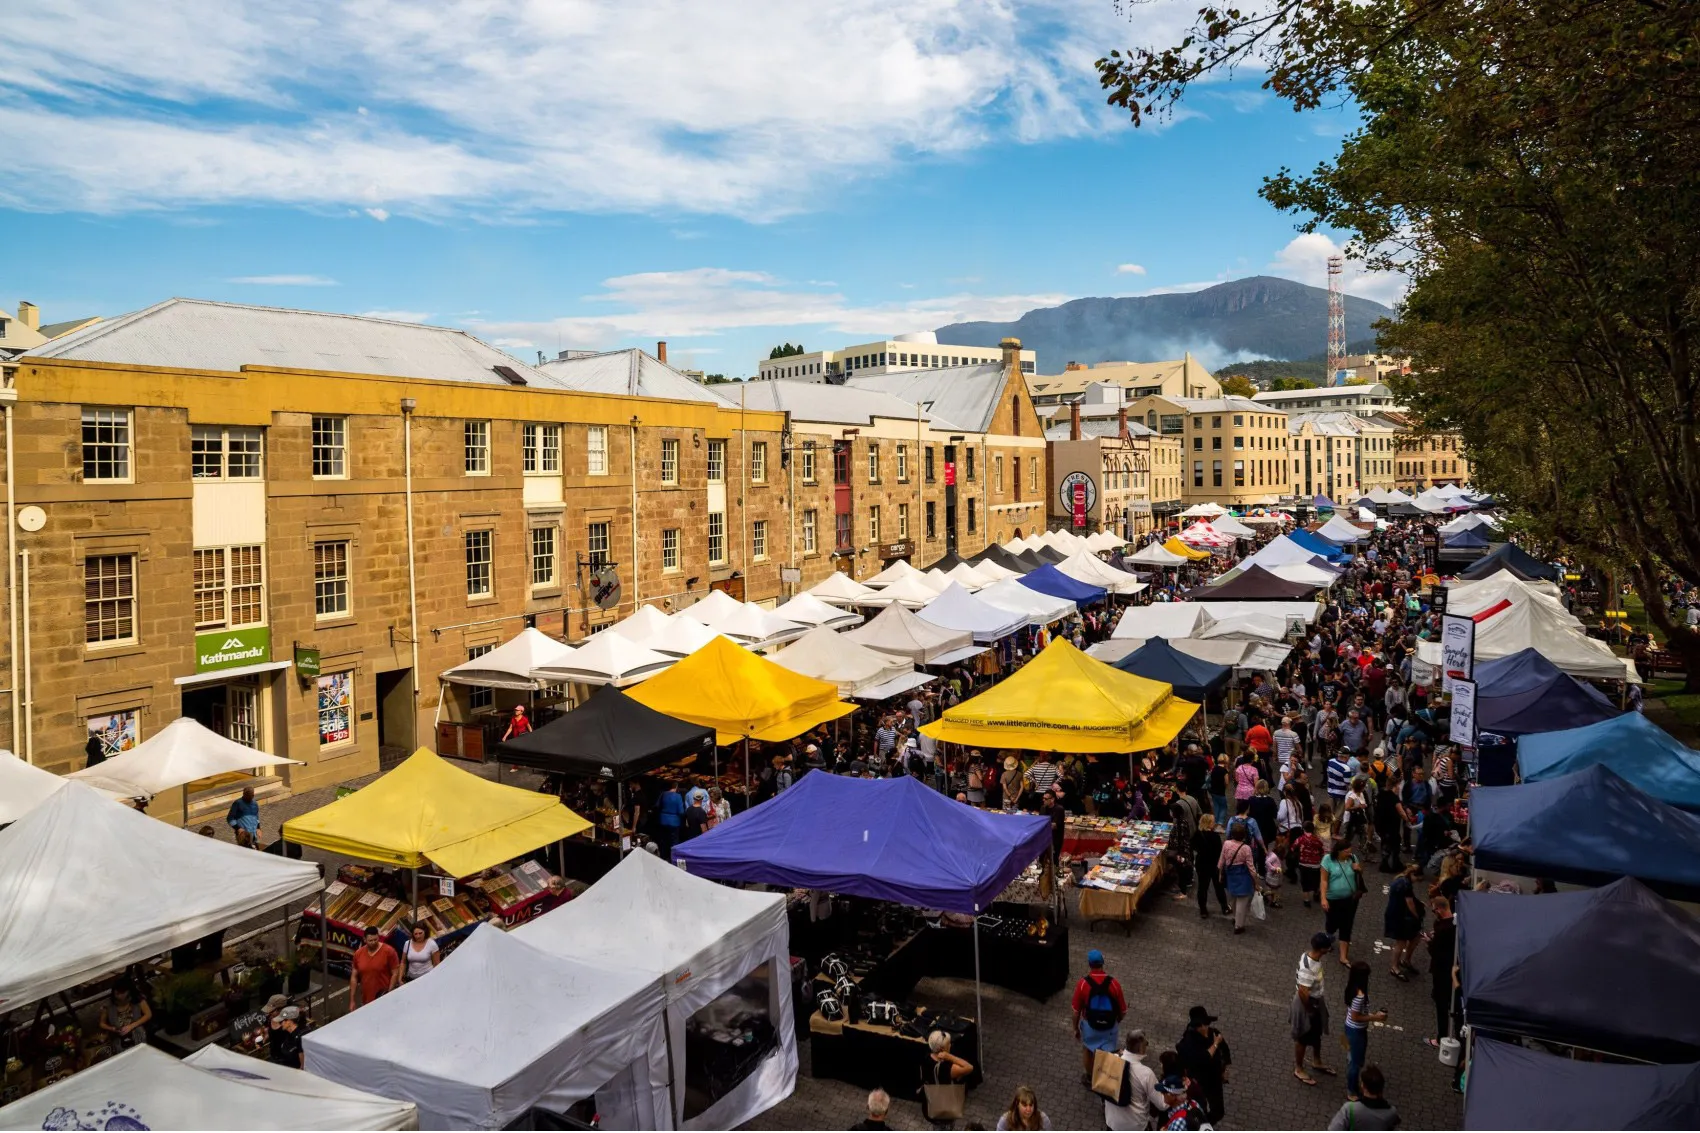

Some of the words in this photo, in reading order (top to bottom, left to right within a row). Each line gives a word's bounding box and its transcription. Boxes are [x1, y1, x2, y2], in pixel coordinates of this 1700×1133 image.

[1067, 474, 1089, 484] FRESH
[201, 648, 263, 666] Kathmandu
[1446, 655, 1466, 668] Here
[297, 661, 319, 670] Kathmandu
[321, 718, 345, 734] sale
[987, 719, 1080, 731] www.littlearmoire.com.au
